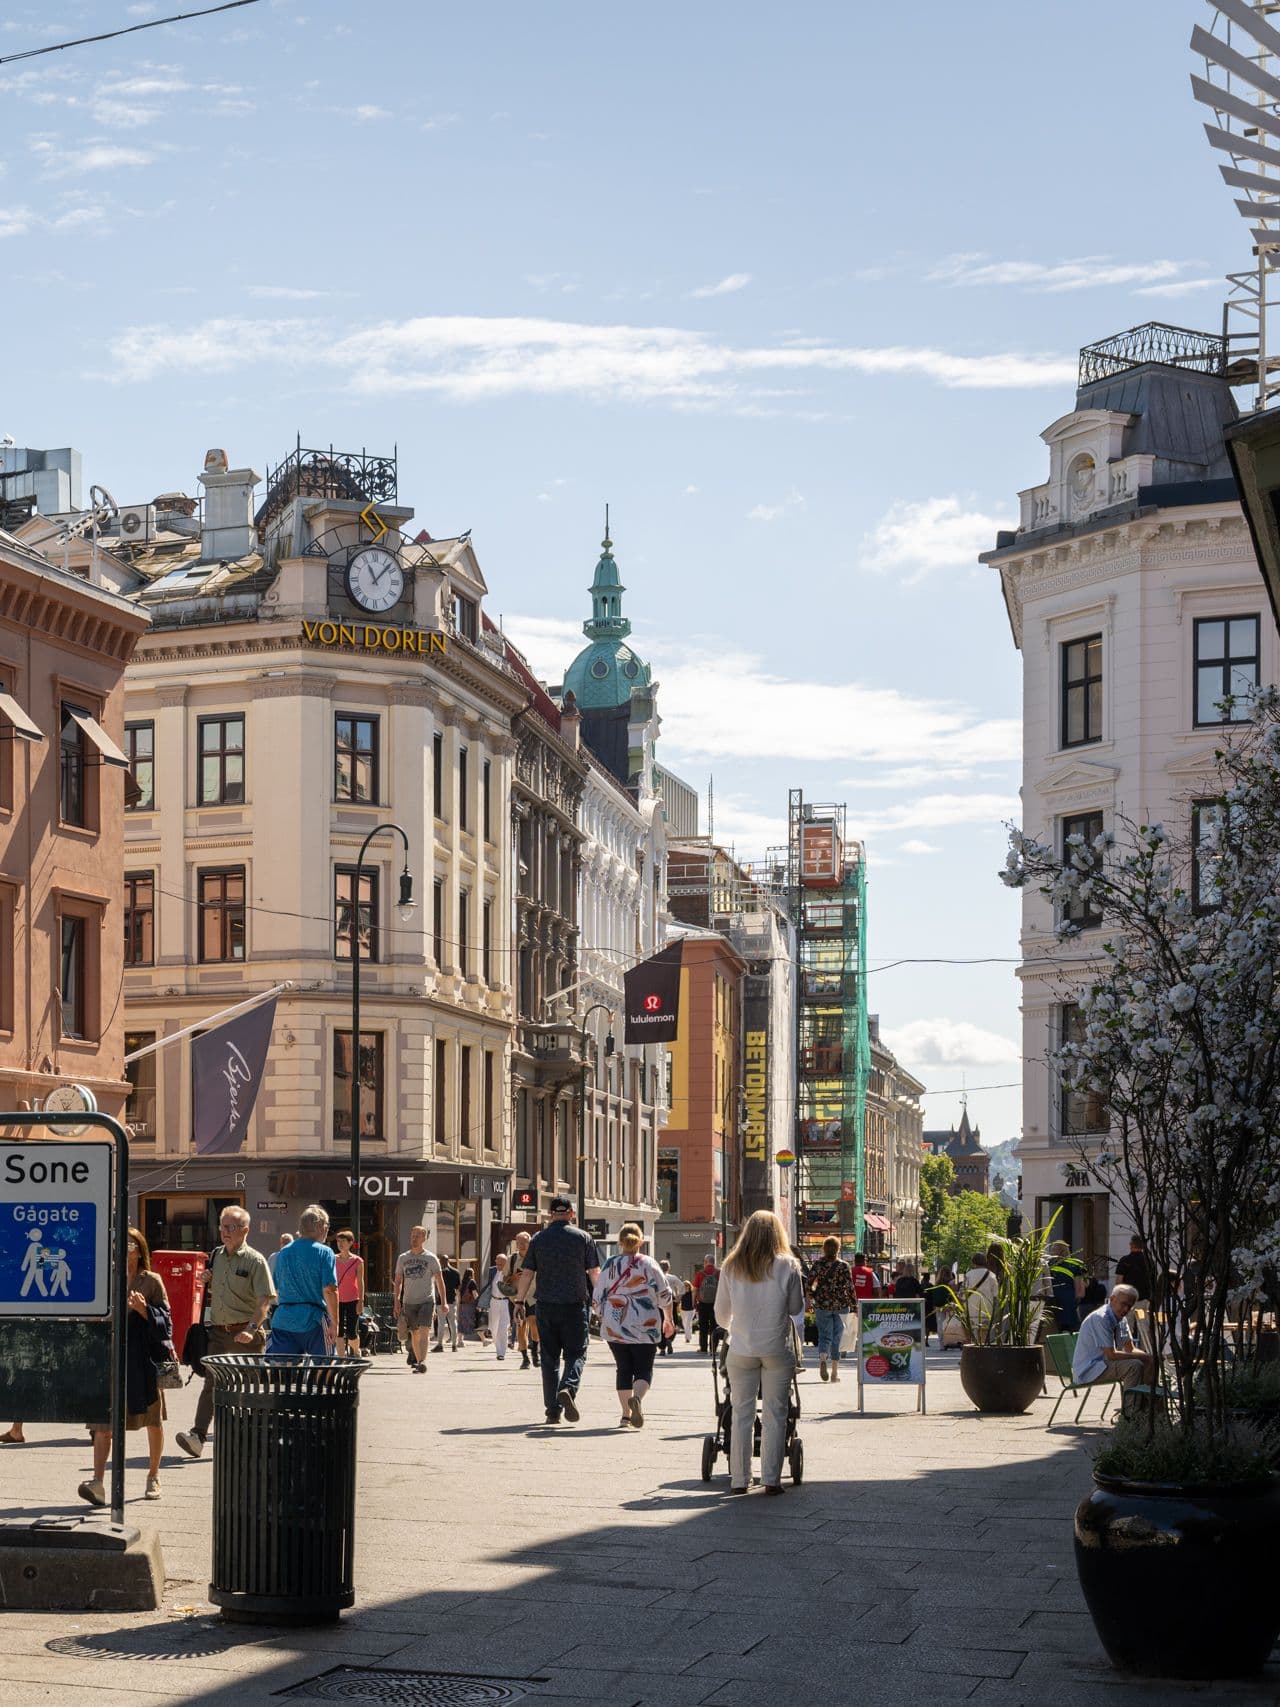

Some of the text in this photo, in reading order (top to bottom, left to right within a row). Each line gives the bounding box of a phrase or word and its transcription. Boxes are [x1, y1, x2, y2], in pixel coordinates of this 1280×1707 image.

[302, 619, 447, 655] VON DOREN
[630, 1014, 675, 1024] lululemon
[745, 1031, 766, 1162] BETONMAST
[128, 1122, 148, 1131] OLT
[4, 1153, 90, 1184] Sone
[13, 1205, 79, 1226] Gågate
[868, 1313, 915, 1322] STRAWBERRY
